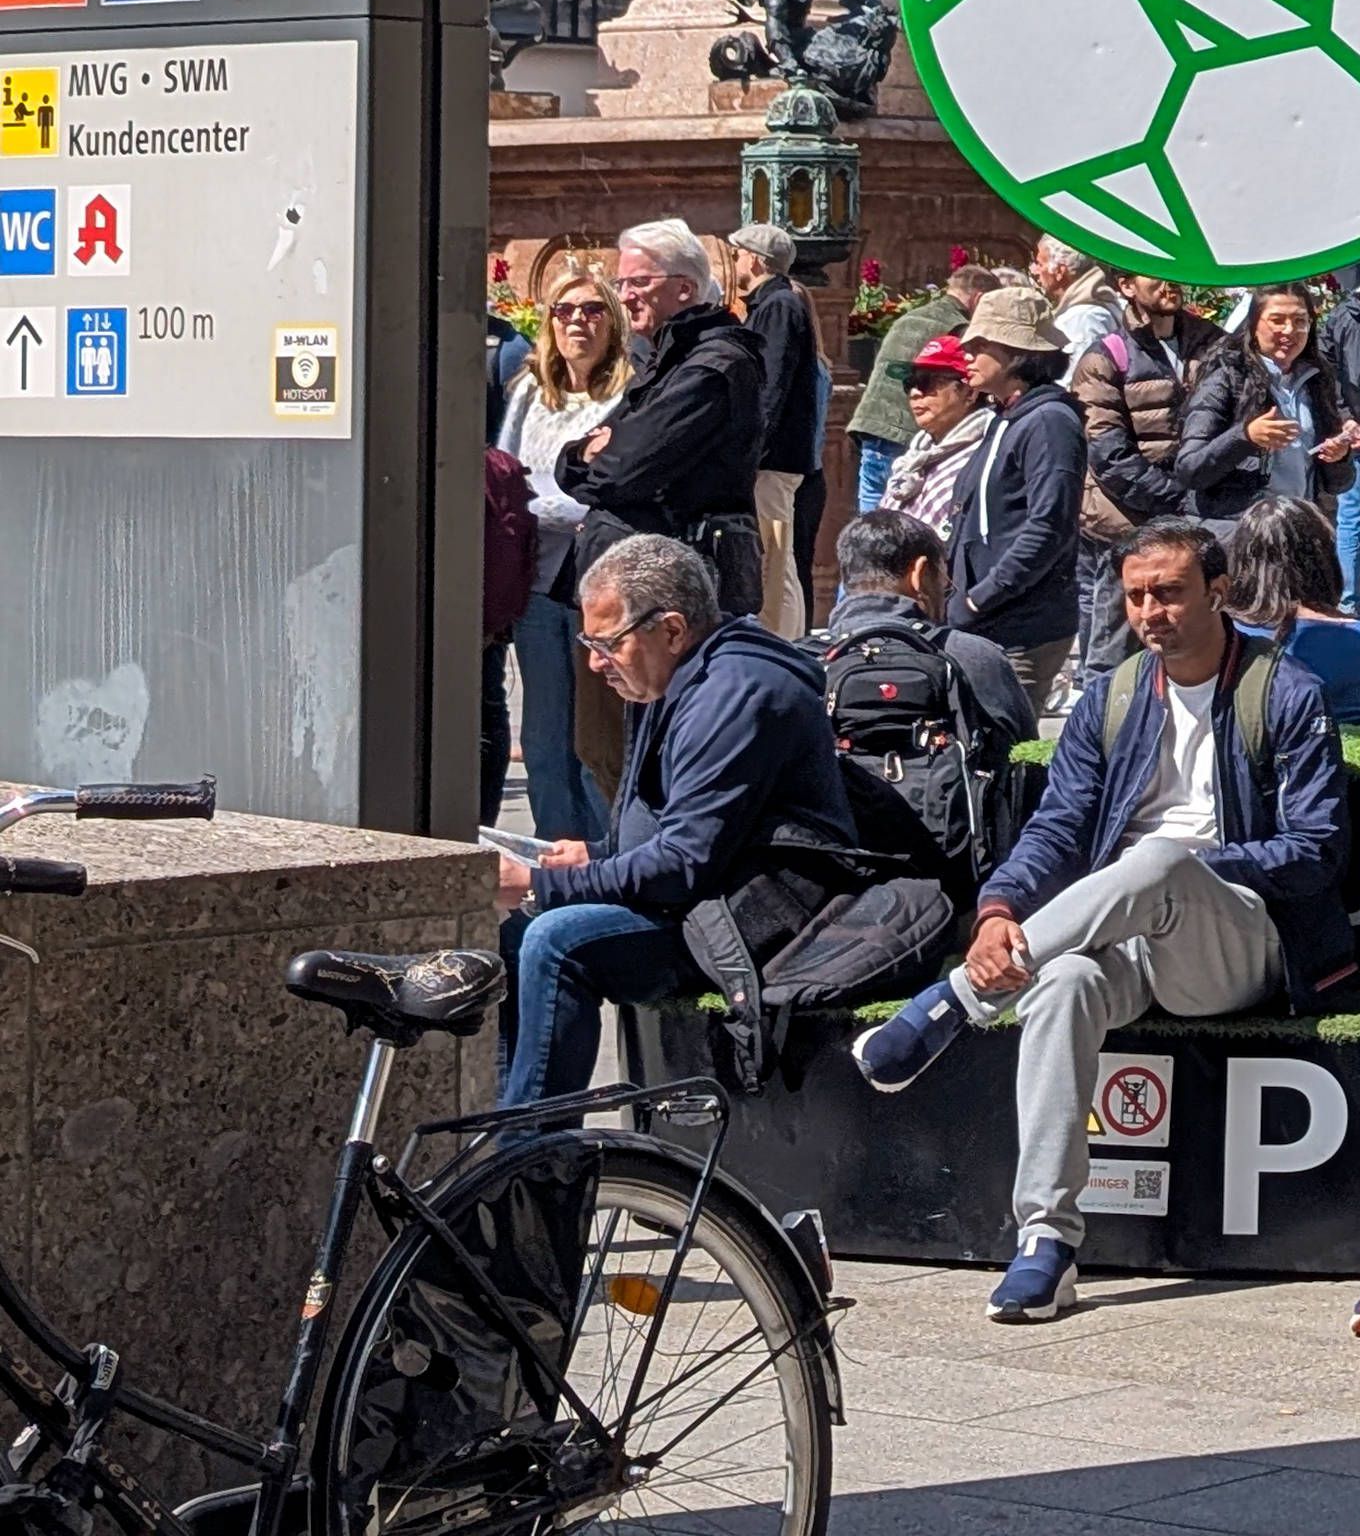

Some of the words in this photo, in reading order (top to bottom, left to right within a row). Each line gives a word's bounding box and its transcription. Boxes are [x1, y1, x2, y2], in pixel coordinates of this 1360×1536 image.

[68, 62, 128, 97] MVG
[163, 58, 229, 94] SWM
[68, 121, 251, 158] Kundencenter
[1, 210, 51, 252] WC
[138, 306, 185, 341] 100
[192, 312, 214, 341] m
[283, 334, 329, 346] M-WLAN
[283, 387, 328, 401] HOTSPOT
